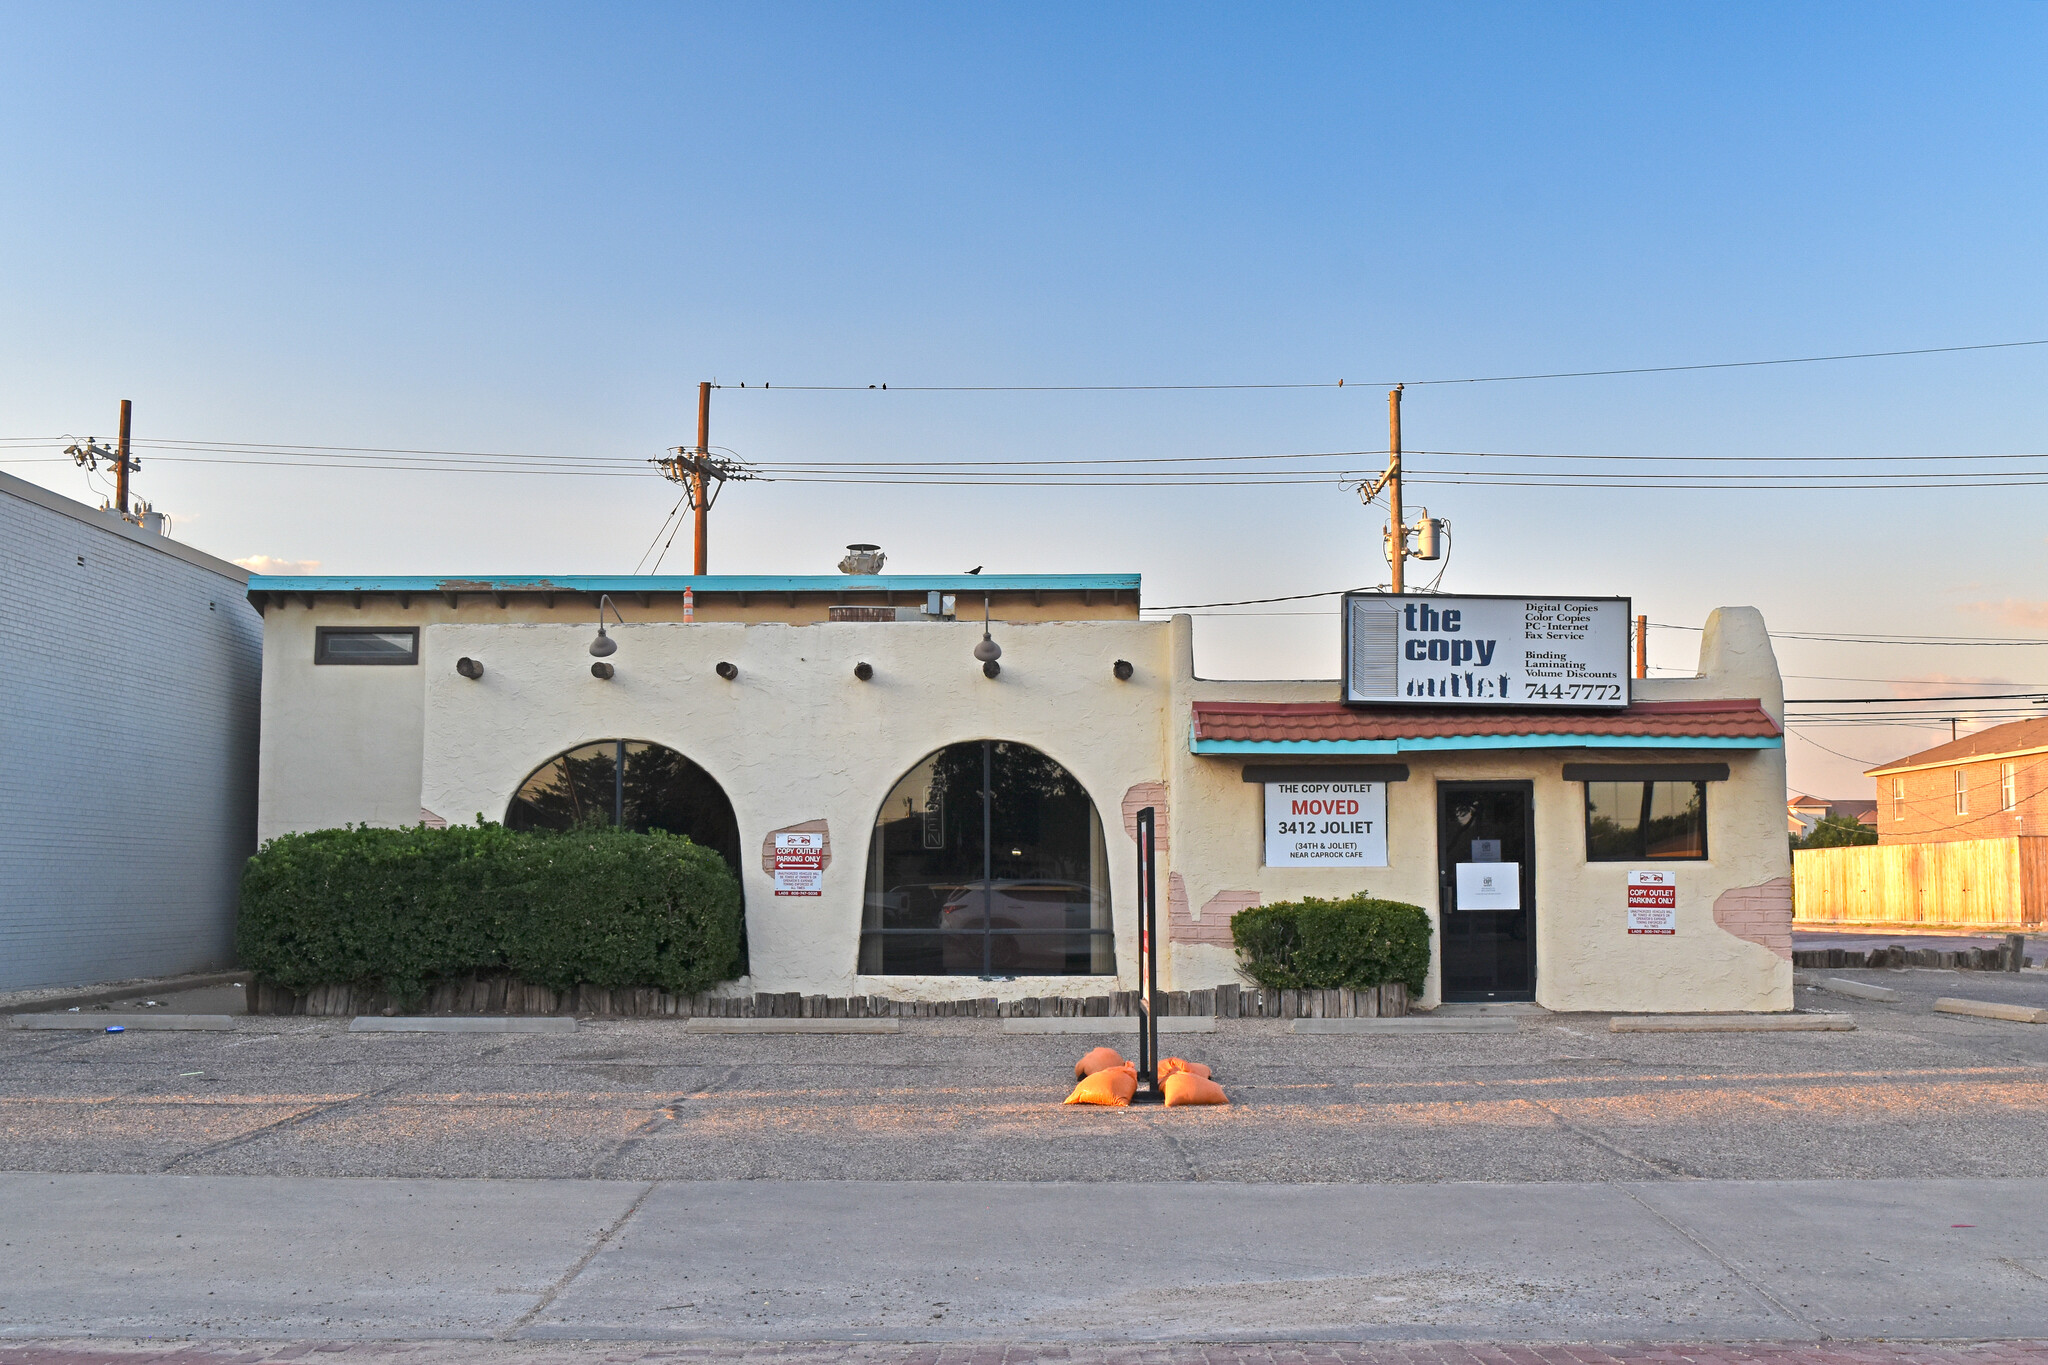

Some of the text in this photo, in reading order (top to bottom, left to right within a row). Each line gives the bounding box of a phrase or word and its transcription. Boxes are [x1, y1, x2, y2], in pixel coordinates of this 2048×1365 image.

[1526, 603, 1598, 613] Digital Copies
[1404, 603, 1461, 632] the
[1525, 613, 1590, 623] Color Copies
[1405, 639, 1496, 666] copy
[1525, 651, 1566, 661] Binding
[1525, 660, 1586, 671] Laminating
[1525, 669, 1617, 678] Volume Discounts
[1525, 683, 1621, 700] 744-7772
[1279, 784, 1372, 793] THE COPY OUTLET
[1292, 800, 1359, 815] MOVED
[1279, 822, 1373, 834] 3412 JOLIET
[1295, 842, 1318, 850] (34TH
[1328, 842, 1357, 850] JOLIET)
